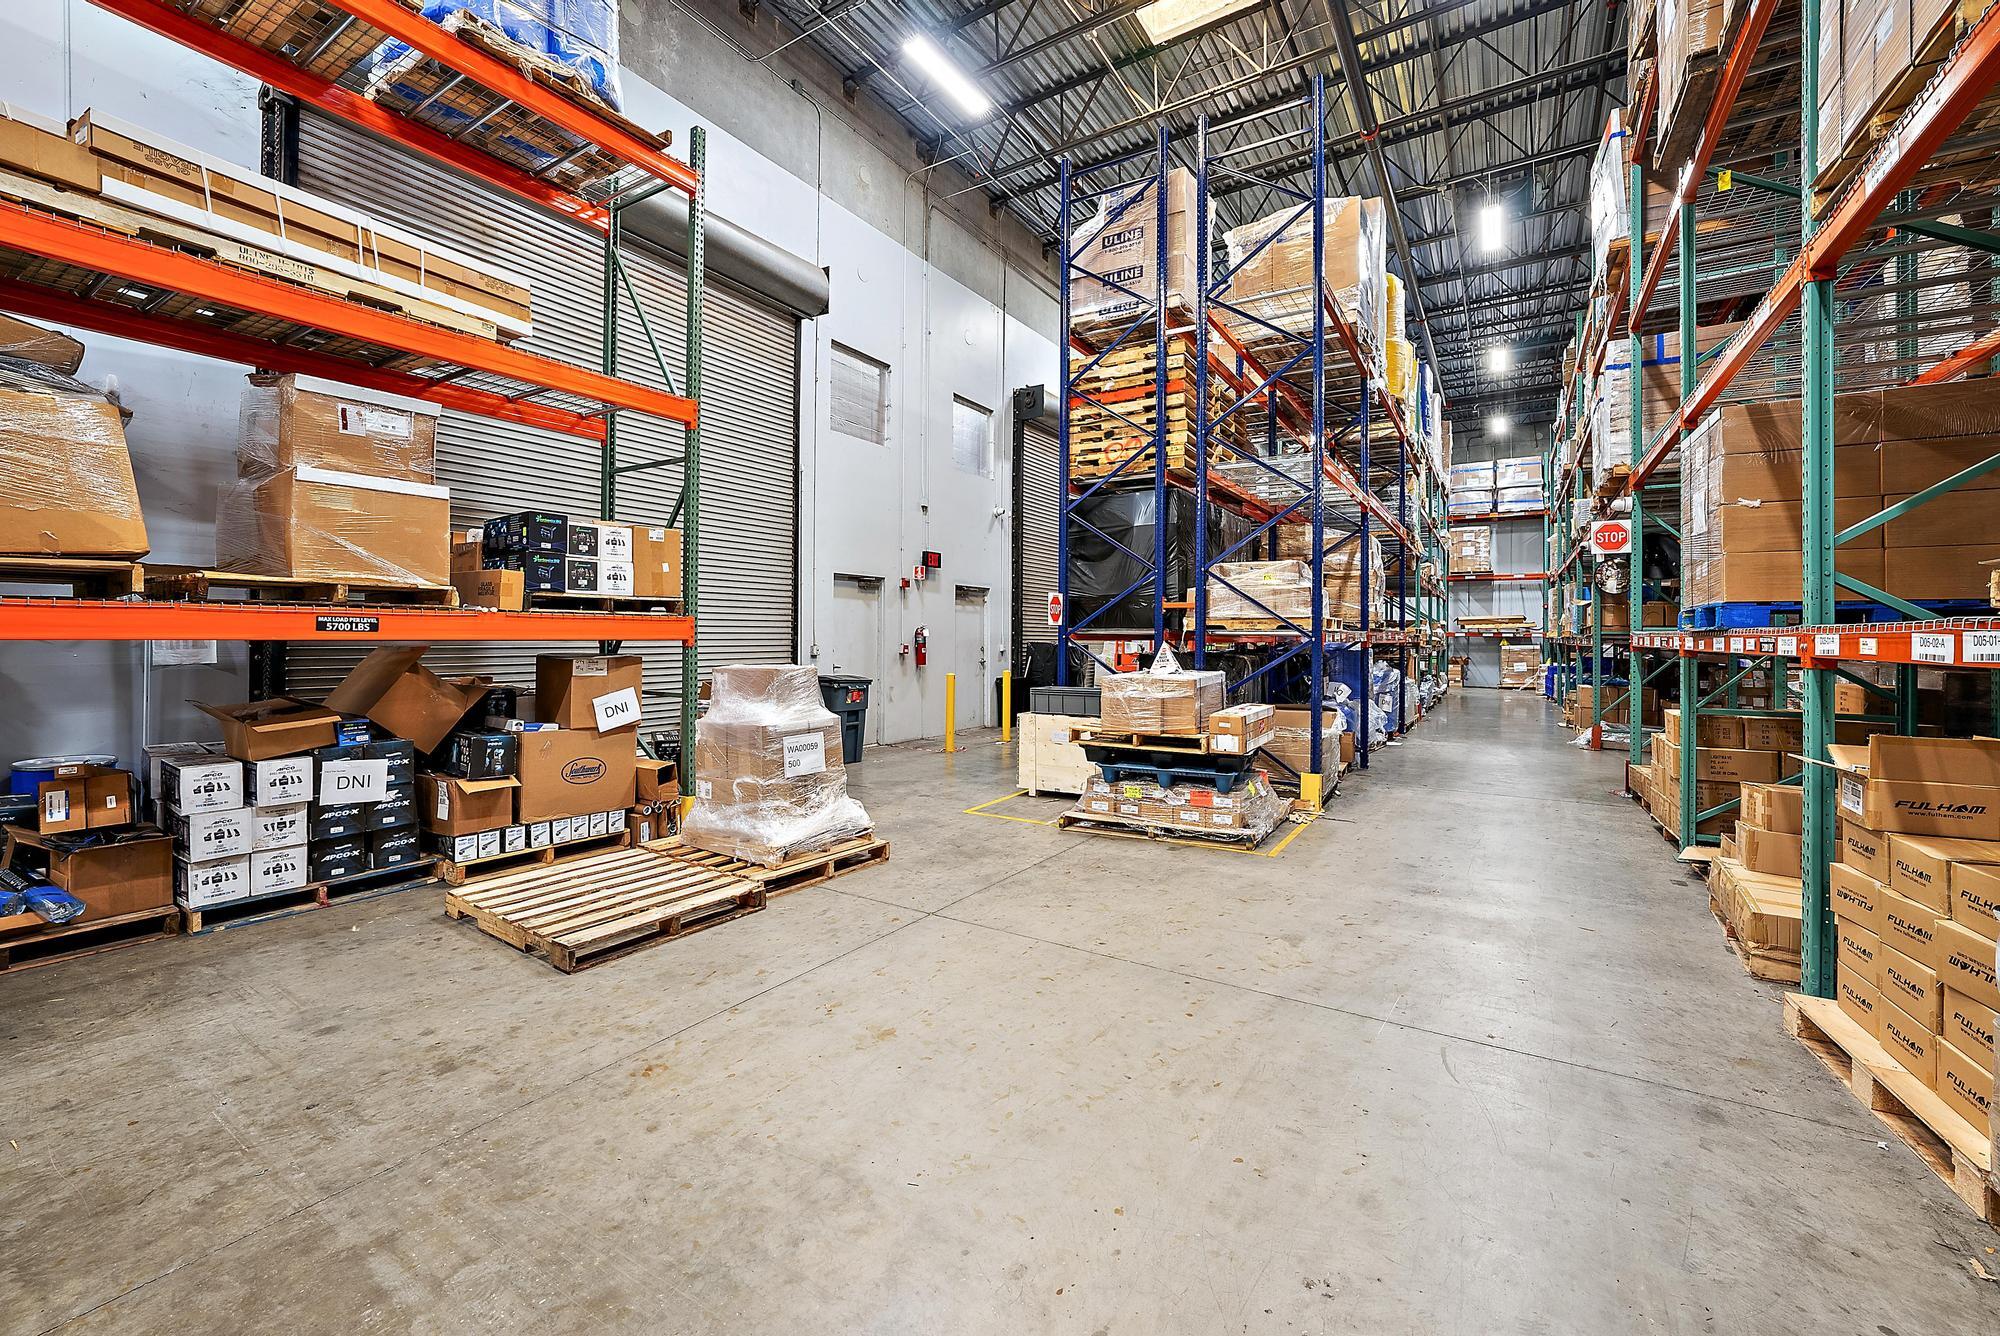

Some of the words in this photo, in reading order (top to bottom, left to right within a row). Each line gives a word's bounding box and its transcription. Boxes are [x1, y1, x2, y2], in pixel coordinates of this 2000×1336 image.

[133, 141, 200, 174] FRAGILE
[144, 154, 190, 176] GLASS
[1104, 229, 1142, 246] ULINE
[1104, 269, 1142, 283] ULINE
[1597, 532, 1627, 543] STOP
[1050, 604, 1062, 615] STOP
[326, 622, 351, 630] 5700
[352, 623, 370, 631] LBS
[1919, 637, 1946, 648] D05-02-A
[1973, 635, 2000, 647] D05-01-
[605, 701, 629, 718] DNI
[787, 742, 818, 753] WA00059
[788, 759, 801, 768] 500
[336, 774, 371, 790] DNI
[1894, 800, 1987, 814] FULHAM
[1908, 811, 1974, 820] www.fulham.com
[1848, 838, 1876, 856] FULHAM
[1895, 860, 1932, 883] FULHAM
[1836, 889, 1874, 912] FULHAM
[1960, 890, 1995, 911] FULH
[1887, 914, 1933, 941] FULHAM
[1843, 936, 1874, 960] FULHAM
[1949, 955, 1997, 986] ULHAM
[1887, 967, 1925, 998] FULHAM
[1842, 983, 1873, 1011] FULHAM
[1953, 1012, 1994, 1044] FULHA
[1887, 1023, 1925, 1057] FULHAM
